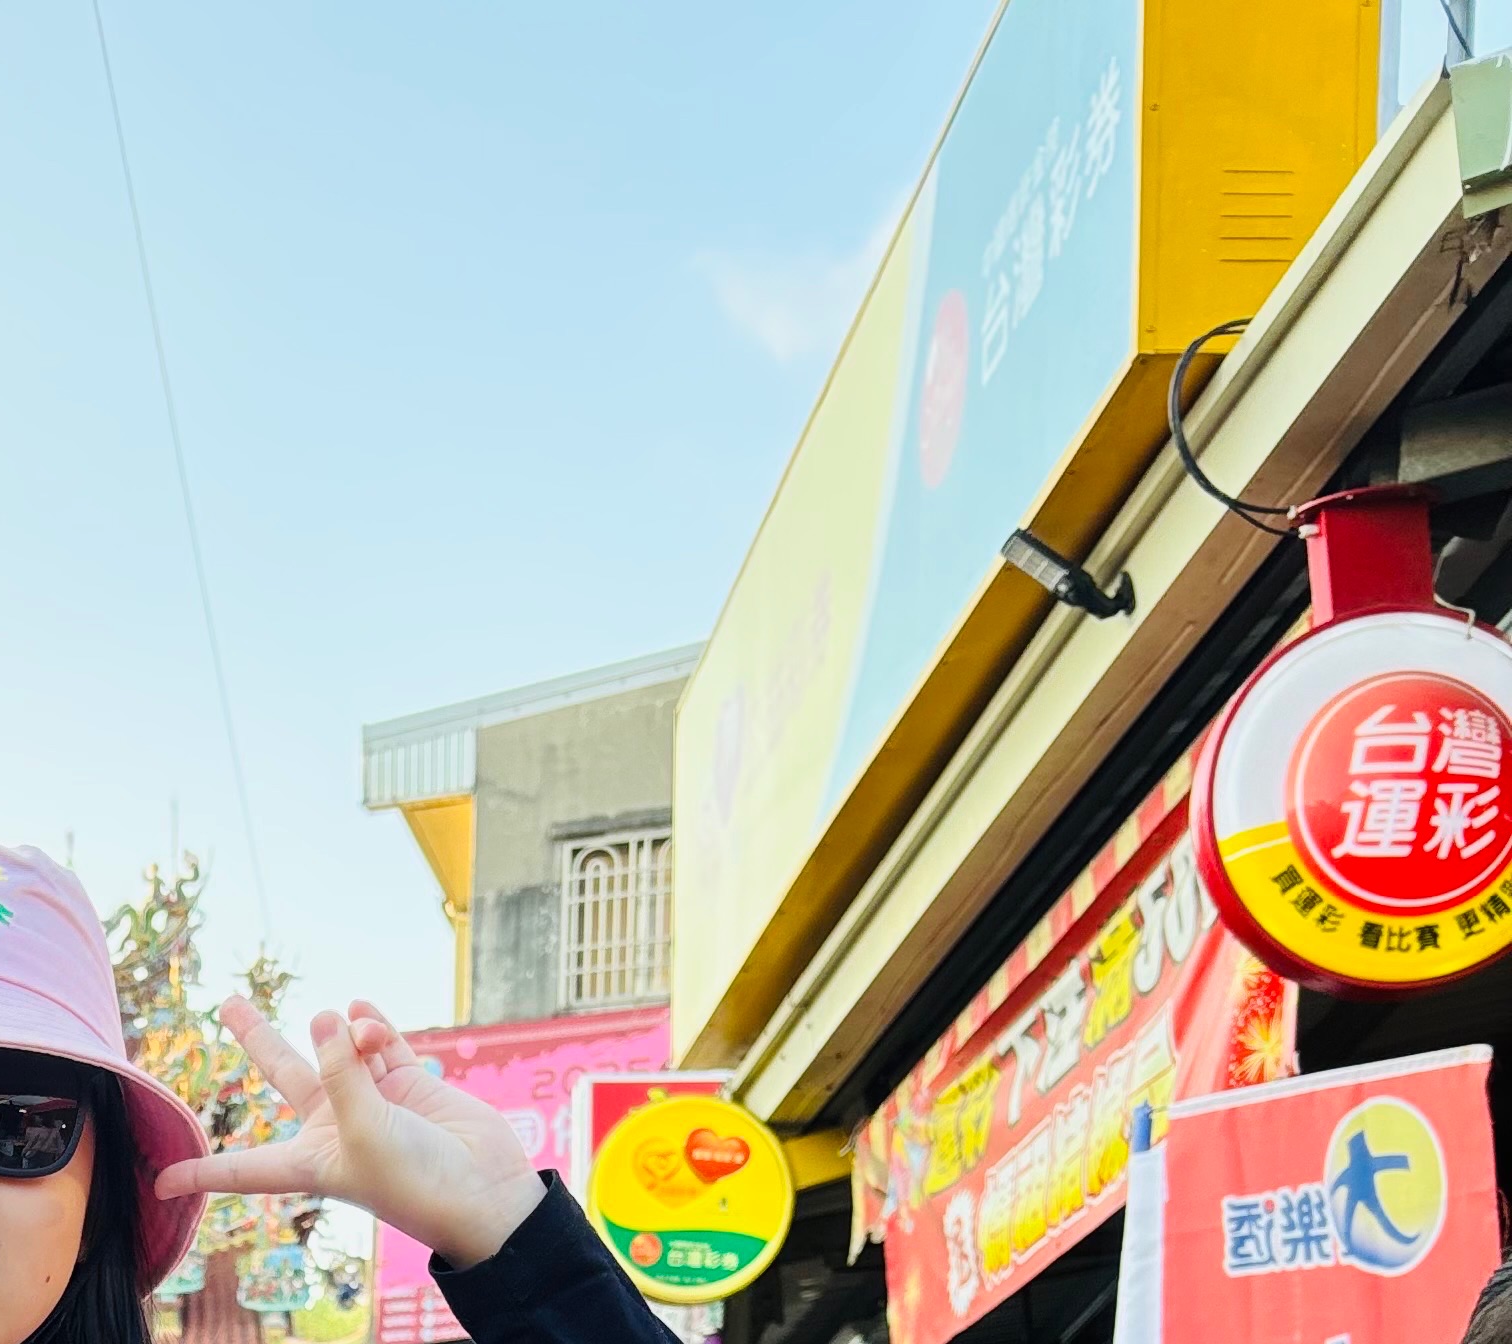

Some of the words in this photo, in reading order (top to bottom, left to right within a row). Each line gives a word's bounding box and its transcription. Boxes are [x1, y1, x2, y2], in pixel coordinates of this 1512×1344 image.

[1348, 704, 1502, 779] 台灣
[1331, 779, 1501, 860] 運彩
[1359, 921, 1441, 953] 看比賽
